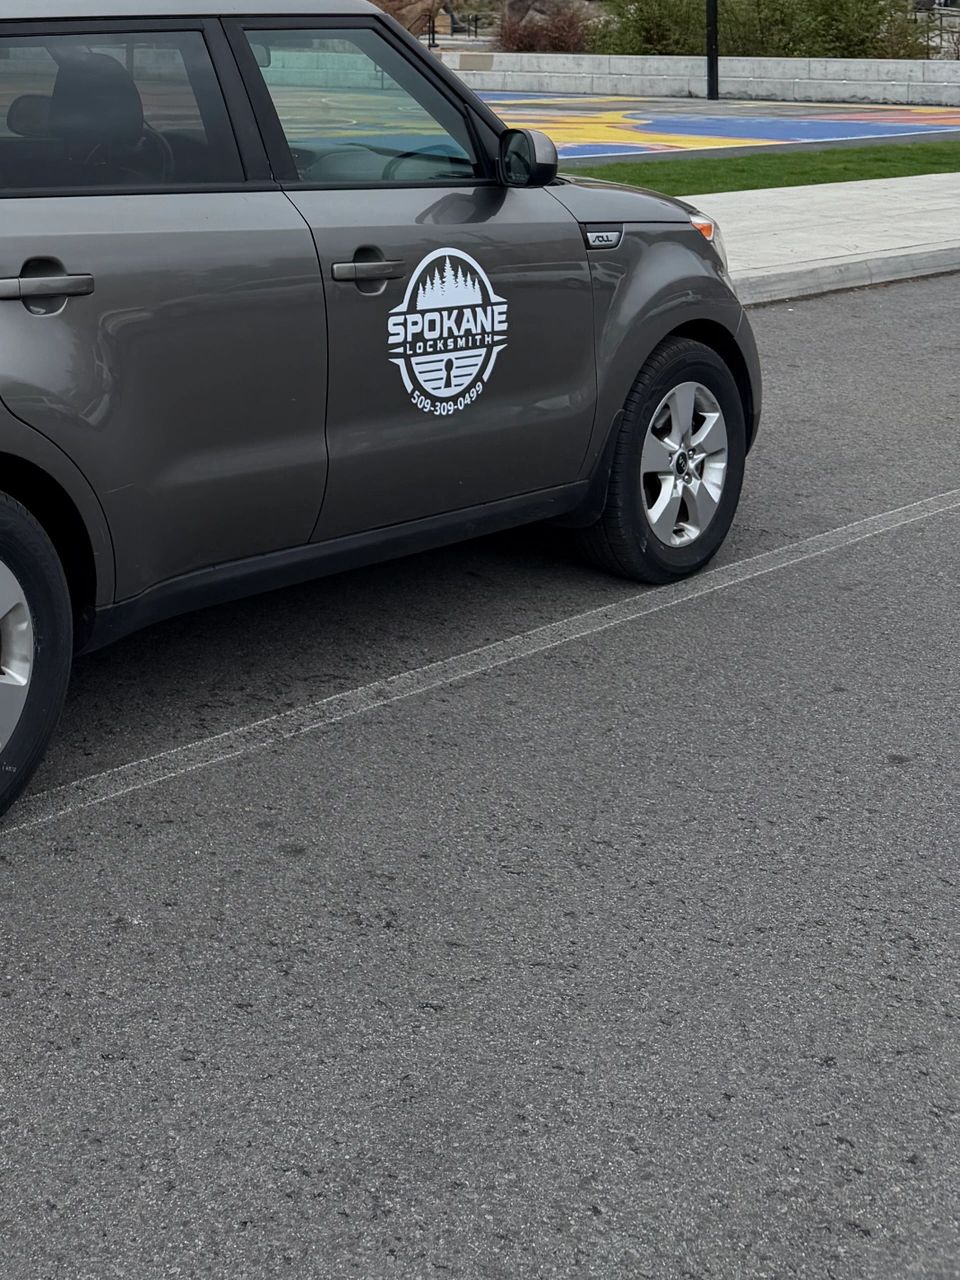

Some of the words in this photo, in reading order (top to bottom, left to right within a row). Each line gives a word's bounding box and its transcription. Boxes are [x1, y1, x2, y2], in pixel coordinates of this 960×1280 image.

[387, 304, 508, 344] SPOKANE
[406, 334, 492, 355] LOCKSMITH
[411, 381, 483, 416] 509-309-0499
